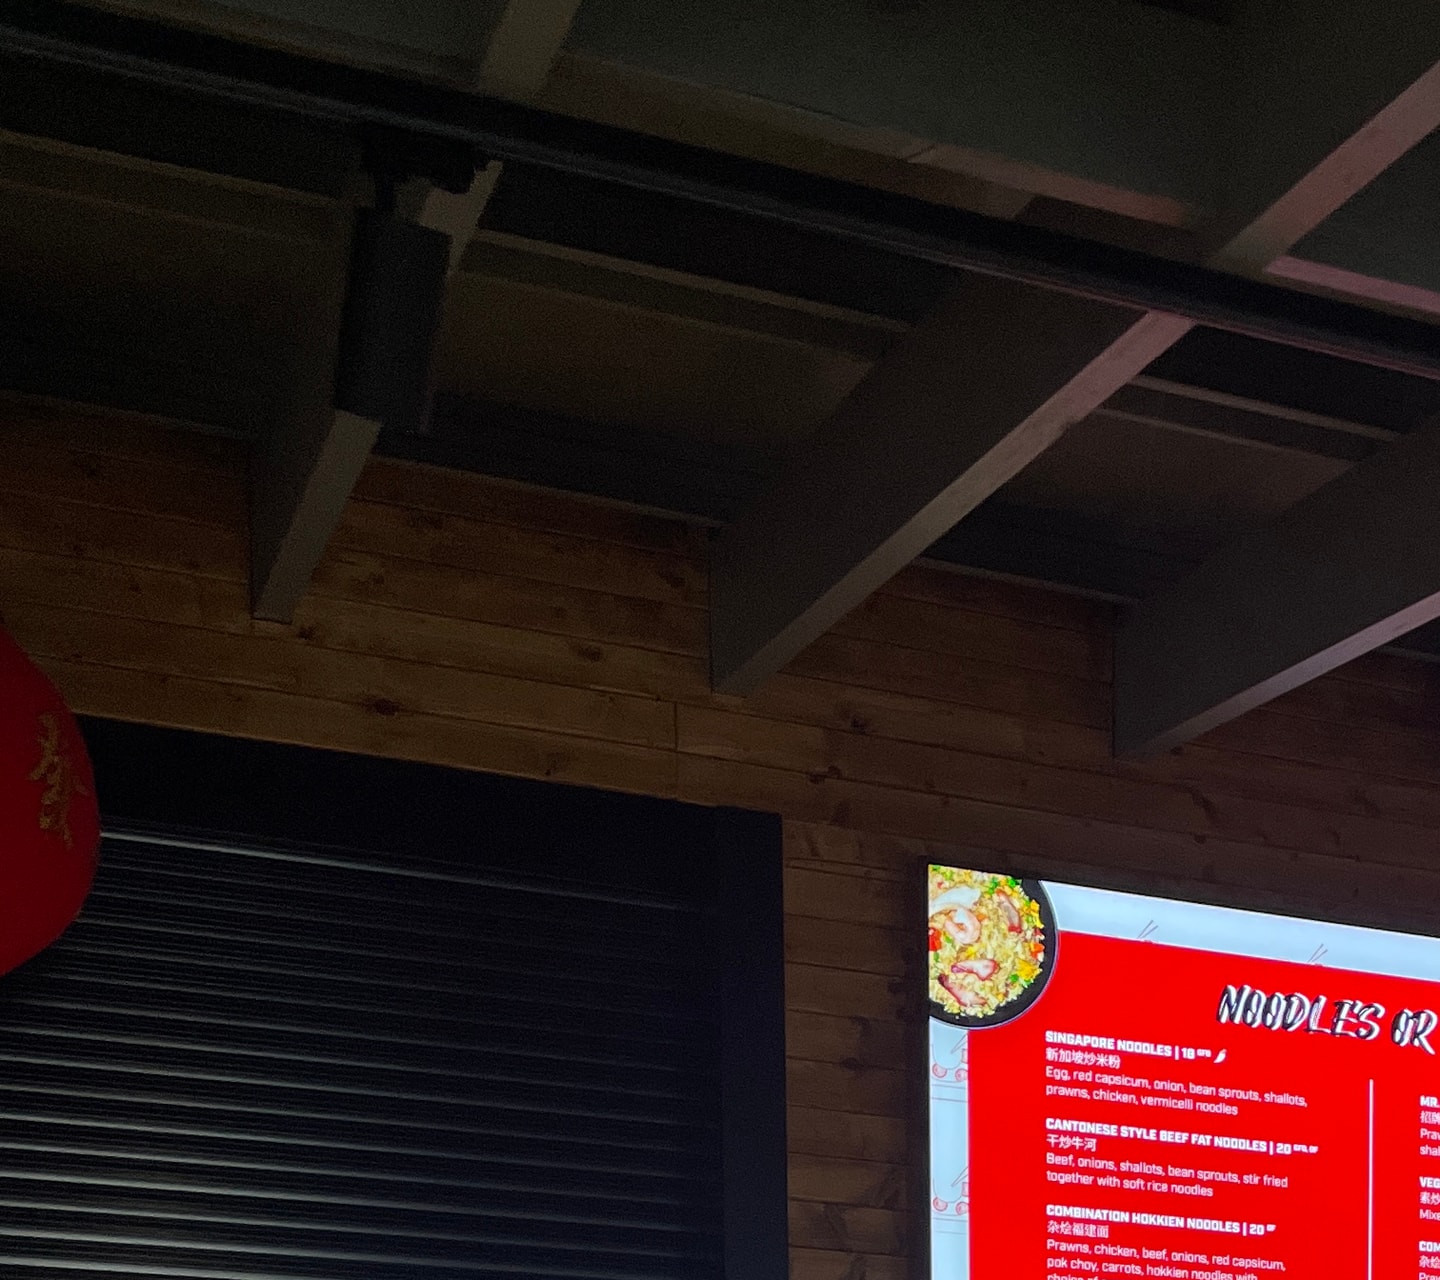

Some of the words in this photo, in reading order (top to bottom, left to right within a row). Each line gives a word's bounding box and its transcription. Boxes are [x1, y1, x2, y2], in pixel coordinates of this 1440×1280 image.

[1218, 984, 1386, 1040] NOODLES
[1389, 1008, 1438, 1055] OR
[1045, 1030, 1115, 1050] SINGAPORE
[1116, 1039, 1172, 1057] NOODLES
[1045, 1065, 1071, 1081] Egg,
[1072, 1070, 1092, 1082] red
[1095, 1073, 1151, 1089] capsicum,
[1153, 1079, 1187, 1093] onion,
[1189, 1082, 1216, 1096] bean
[1218, 1087, 1262, 1102] sprouts,
[1263, 1091, 1308, 1107] shallots,
[1045, 1084, 1091, 1100] prawns,
[1092, 1088, 1138, 1105] chicken,
[1140, 1095, 1193, 1110] vermicelli
[1195, 1101, 1238, 1115] noodles
[1419, 1095, 1440, 1108] MR.
[1045, 1117, 1118, 1136] CANTONESE
[1120, 1125, 1157, 1140] STYLE
[1159, 1129, 1189, 1143] BEEF
[1191, 1133, 1212, 1146] FAT
[1213, 1135, 1267, 1152] NOODLES
[1276, 1142, 1292, 1155] 20
[1046, 1151, 1075, 1167] Beef,
[1077, 1156, 1117, 1171] onions,
[1119, 1159, 1166, 1176] shallots,
[1167, 1164, 1195, 1178] bean
[1196, 1169, 1241, 1184] sprouts,
[1242, 1173, 1261, 1184] stir
[1262, 1174, 1288, 1188] fried
[1046, 1204, 1130, 1223] COMBINATION
[1131, 1212, 1184, 1228] HOKKIEN
[1186, 1217, 1240, 1233] NOODLES
[1249, 1223, 1265, 1235] 20
